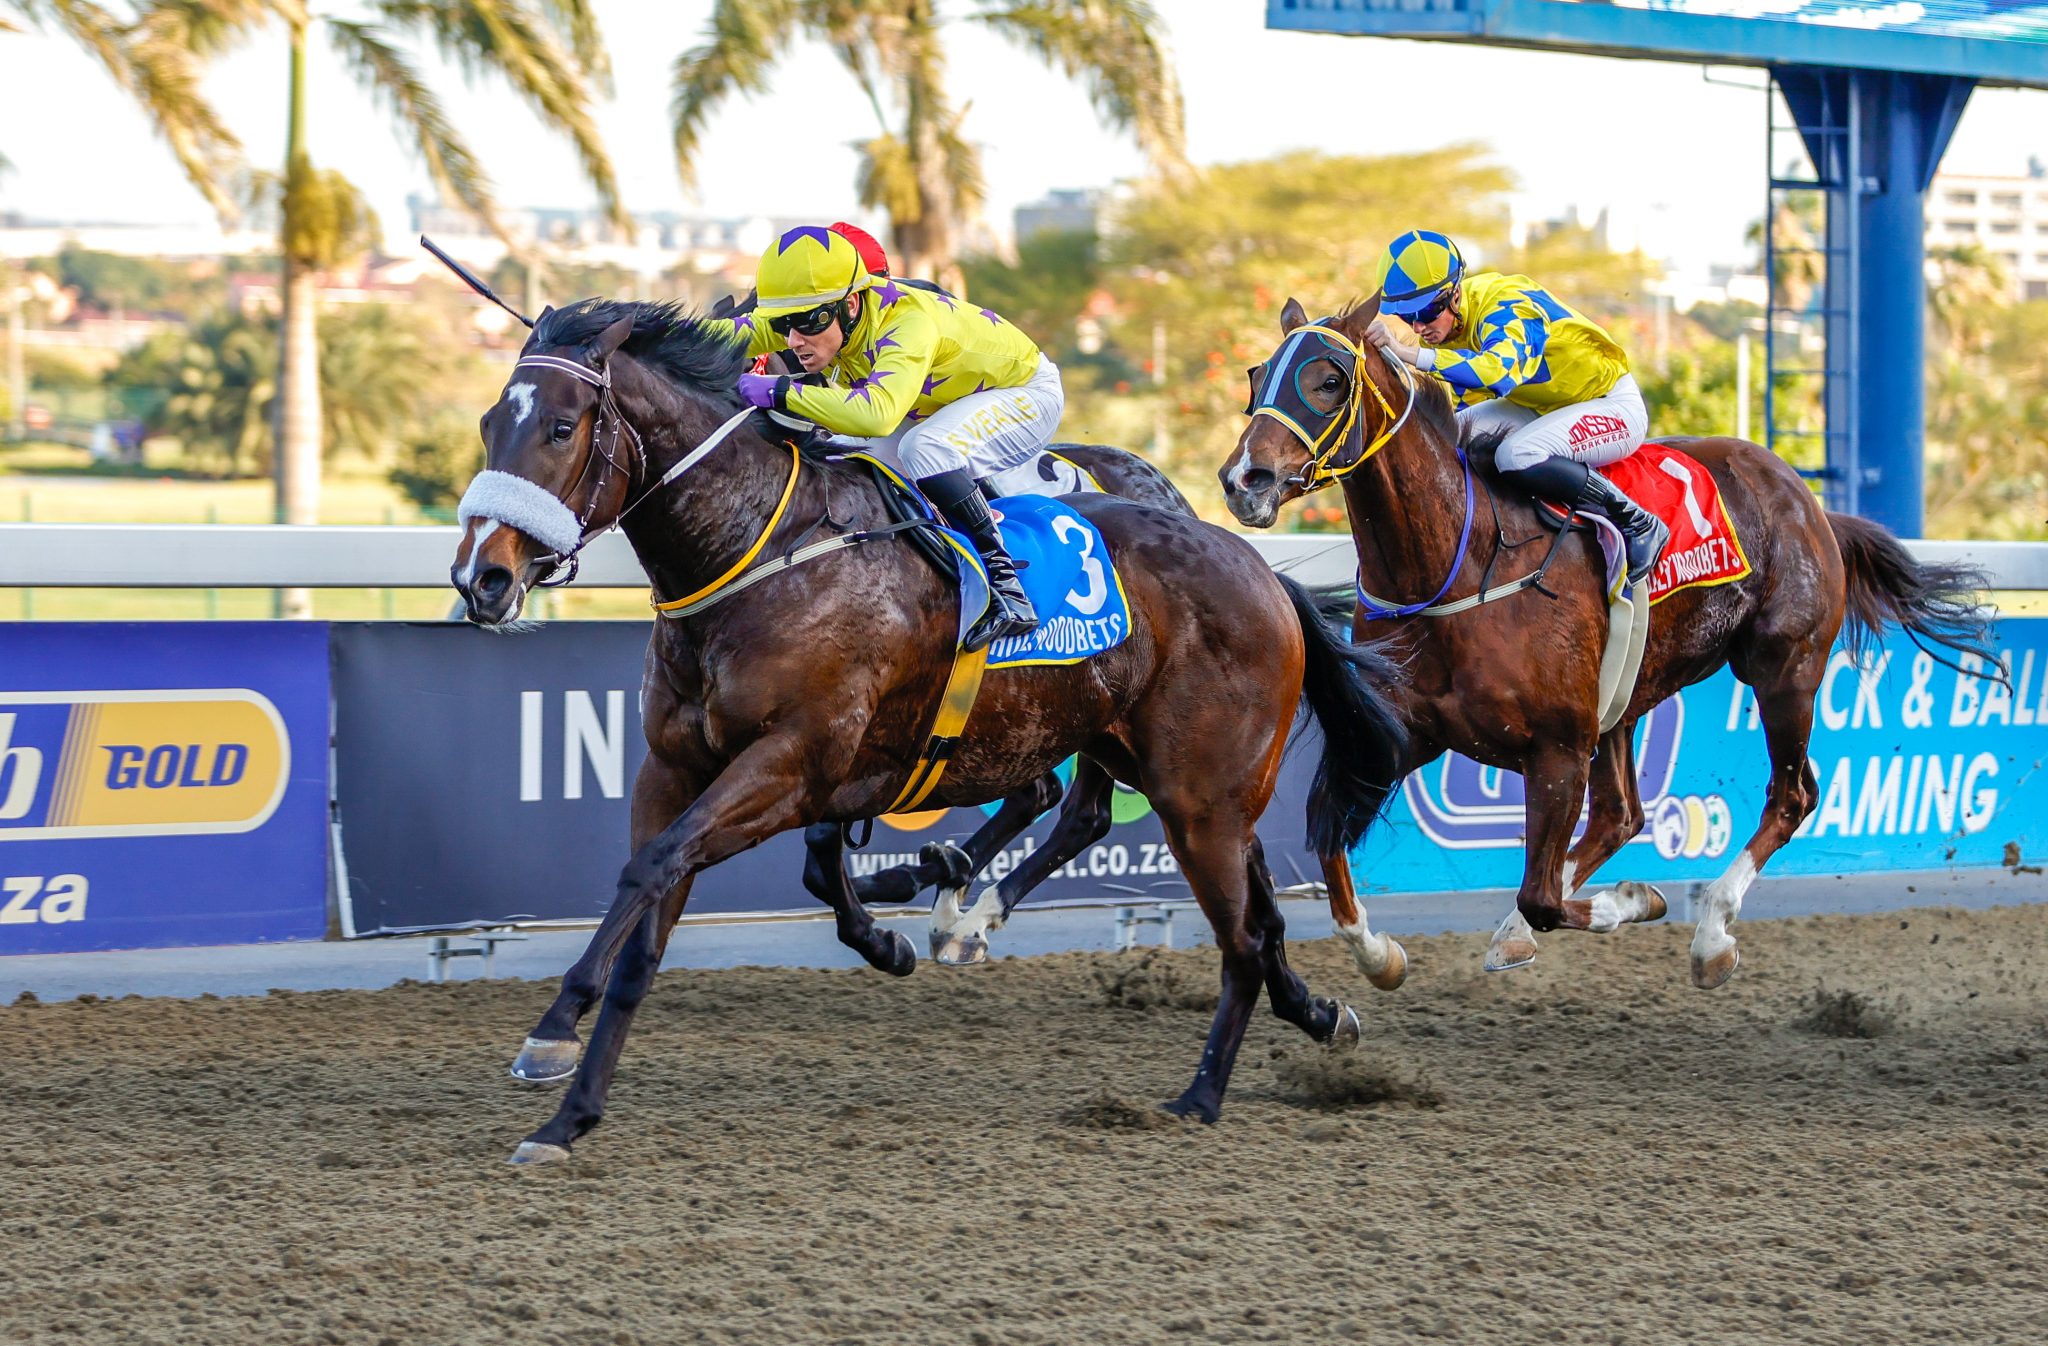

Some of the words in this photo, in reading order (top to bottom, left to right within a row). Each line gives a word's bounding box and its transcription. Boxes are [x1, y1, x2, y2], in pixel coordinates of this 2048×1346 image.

[1568, 414, 1628, 445] JONSSON
[1659, 456, 1713, 539] 1
[1051, 514, 1108, 615] 3
[1901, 649, 1936, 729] &
[98, 742, 250, 790] GOLD
[519, 689, 642, 802] IN
[1792, 751, 2000, 839] AMING
